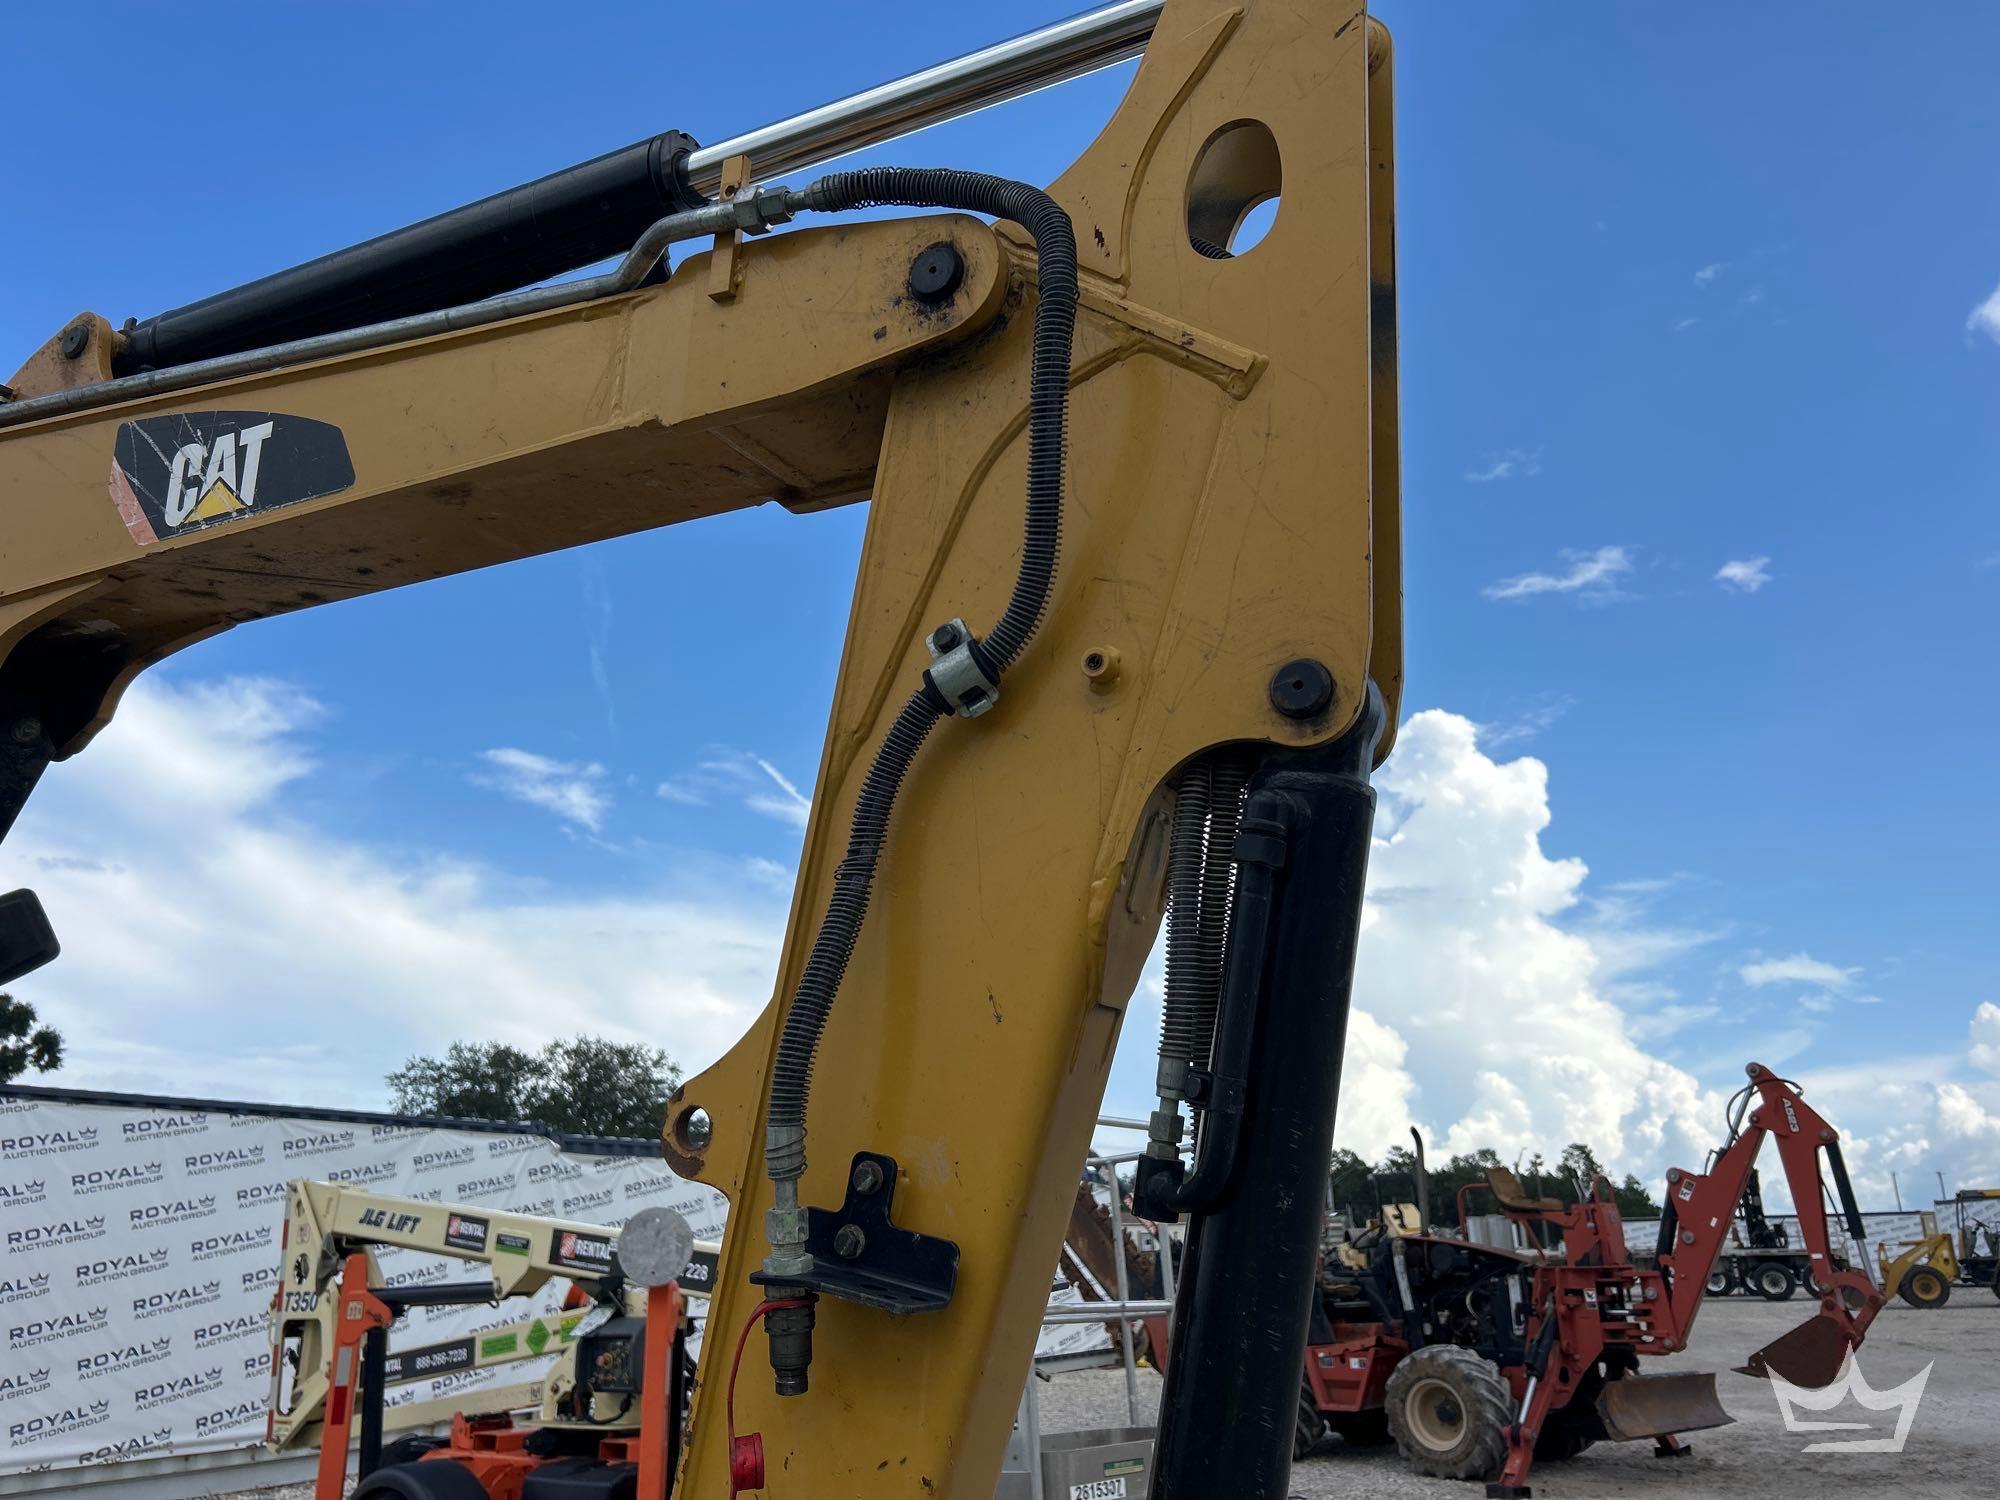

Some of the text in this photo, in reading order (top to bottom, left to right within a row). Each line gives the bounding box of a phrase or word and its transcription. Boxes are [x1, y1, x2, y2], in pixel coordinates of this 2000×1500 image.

[165, 421, 274, 527] CAT
[122, 1116, 190, 1135] ROYAL
[1, 1131, 79, 1151] ROYAL
[125, 1130, 172, 1143] AUCTION
[283, 1133, 340, 1151] ROYAL
[3, 1147, 57, 1160] AUCTION
[185, 1150, 249, 1168] ROYAL
[413, 1150, 462, 1166] ROYAL
[72, 1166, 144, 1187] ROYAL
[457, 1176, 503, 1194] ROYAL
[73, 1182, 124, 1195] AUCTION
[236, 1183, 285, 1200] ROYA
[129, 1200, 198, 1221] ROYAL
[358, 1207, 422, 1234] JLG LIFT
[7, 1221, 85, 1244] ROYAL
[191, 1231, 255, 1253] ROYAL
[9, 1238, 63, 1254] AUCTION
[76, 1254, 149, 1278] ROYAL
[684, 1263, 709, 1281] 228
[77, 1271, 128, 1288] AUCTION
[242, 1267, 281, 1285] ROY
[133, 1286, 203, 1311] ROYAL
[9, 1314, 87, 1340] ROYAL
[194, 1315, 259, 1341] ROYAL
[242, 1323, 271, 1337] GROU
[10, 1332, 65, 1351] AUCTION
[77, 1344, 151, 1372] ROYAL
[78, 1363, 130, 1381] AUCTION
[7, 1383, 50, 1400] GROUP
[135, 1374, 204, 1403] ROYAL
[9, 1407, 89, 1438] ROYAL
[196, 1400, 261, 1429] ROYAL
[10, 1426, 66, 1448] AUCTION
[79, 1435, 153, 1465] ROYAL
